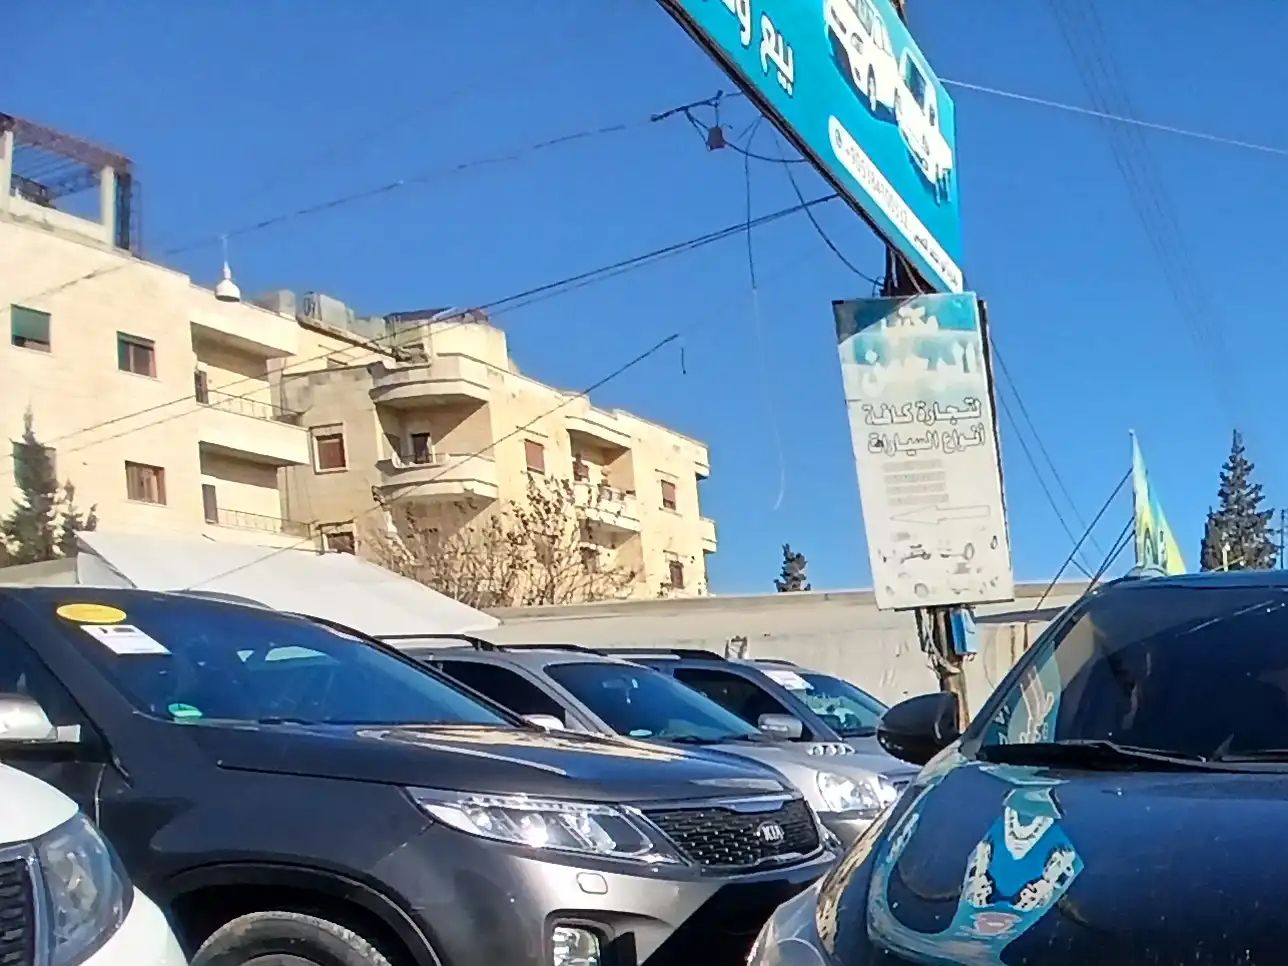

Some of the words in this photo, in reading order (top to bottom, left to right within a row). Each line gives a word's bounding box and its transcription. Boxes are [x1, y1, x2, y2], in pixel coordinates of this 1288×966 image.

[760, 11, 794, 98] بيع
[861, 402, 914, 426] كافة
[915, 396, 983, 426] لتجارة
[867, 430, 939, 457] السيارات
[942, 423, 986, 454] أنواع
[762, 824, 784, 842] KIA
